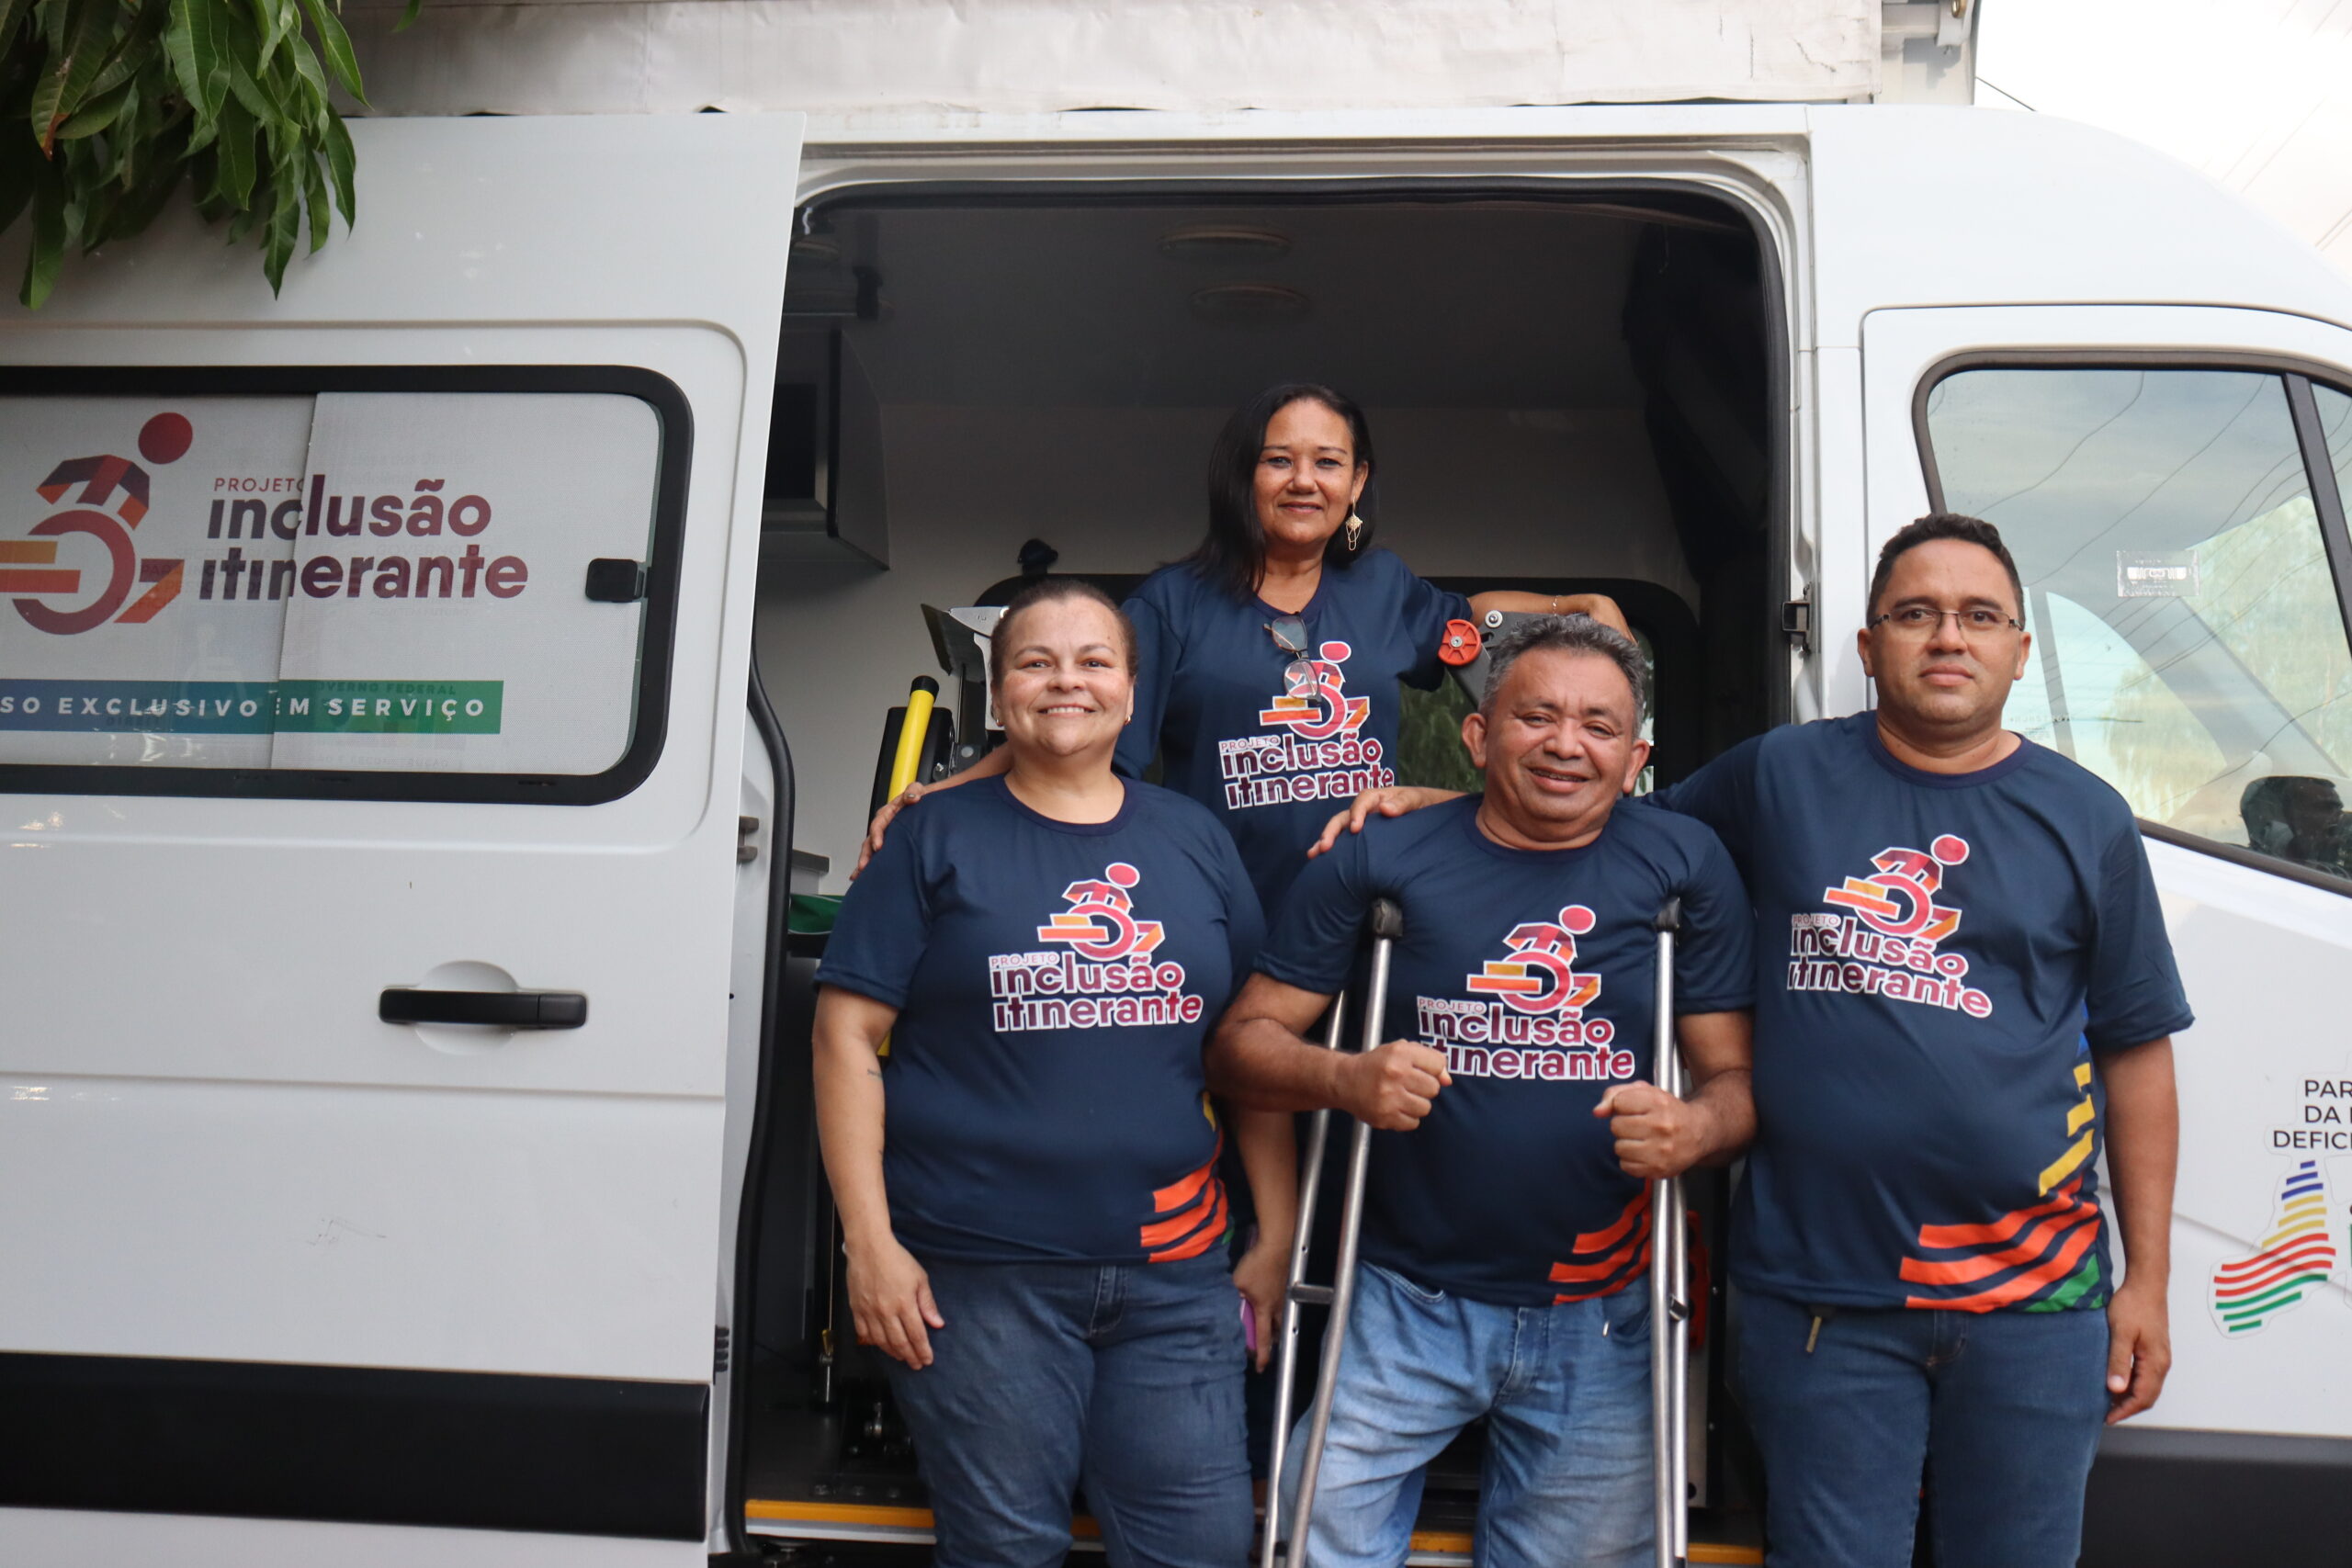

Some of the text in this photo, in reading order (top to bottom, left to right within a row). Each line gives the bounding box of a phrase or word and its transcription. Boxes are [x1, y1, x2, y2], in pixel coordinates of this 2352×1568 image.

[207, 474, 492, 540] inclusão
[198, 545, 528, 601] itinerante
[58, 697, 258, 717] EXCLUSIVO
[327, 698, 484, 721] SERVIÇO
[1220, 738, 1281, 751] PROJETO
[1222, 733, 1382, 776] inclusão
[1227, 763, 1395, 807] itinerante
[1792, 914, 1839, 926] PROJETO
[990, 953, 1057, 967] PROJETO
[1792, 919, 1968, 976] inclusão
[992, 953, 1183, 995] inclusão
[1788, 956, 1991, 1016] itinerante
[995, 991, 1203, 1031] itinerante
[1418, 998, 1486, 1013] PROJETO
[1419, 1005, 1613, 1045] inclusão
[1422, 1039, 1635, 1078] inerante
[2304, 1105, 2342, 1124] DA
